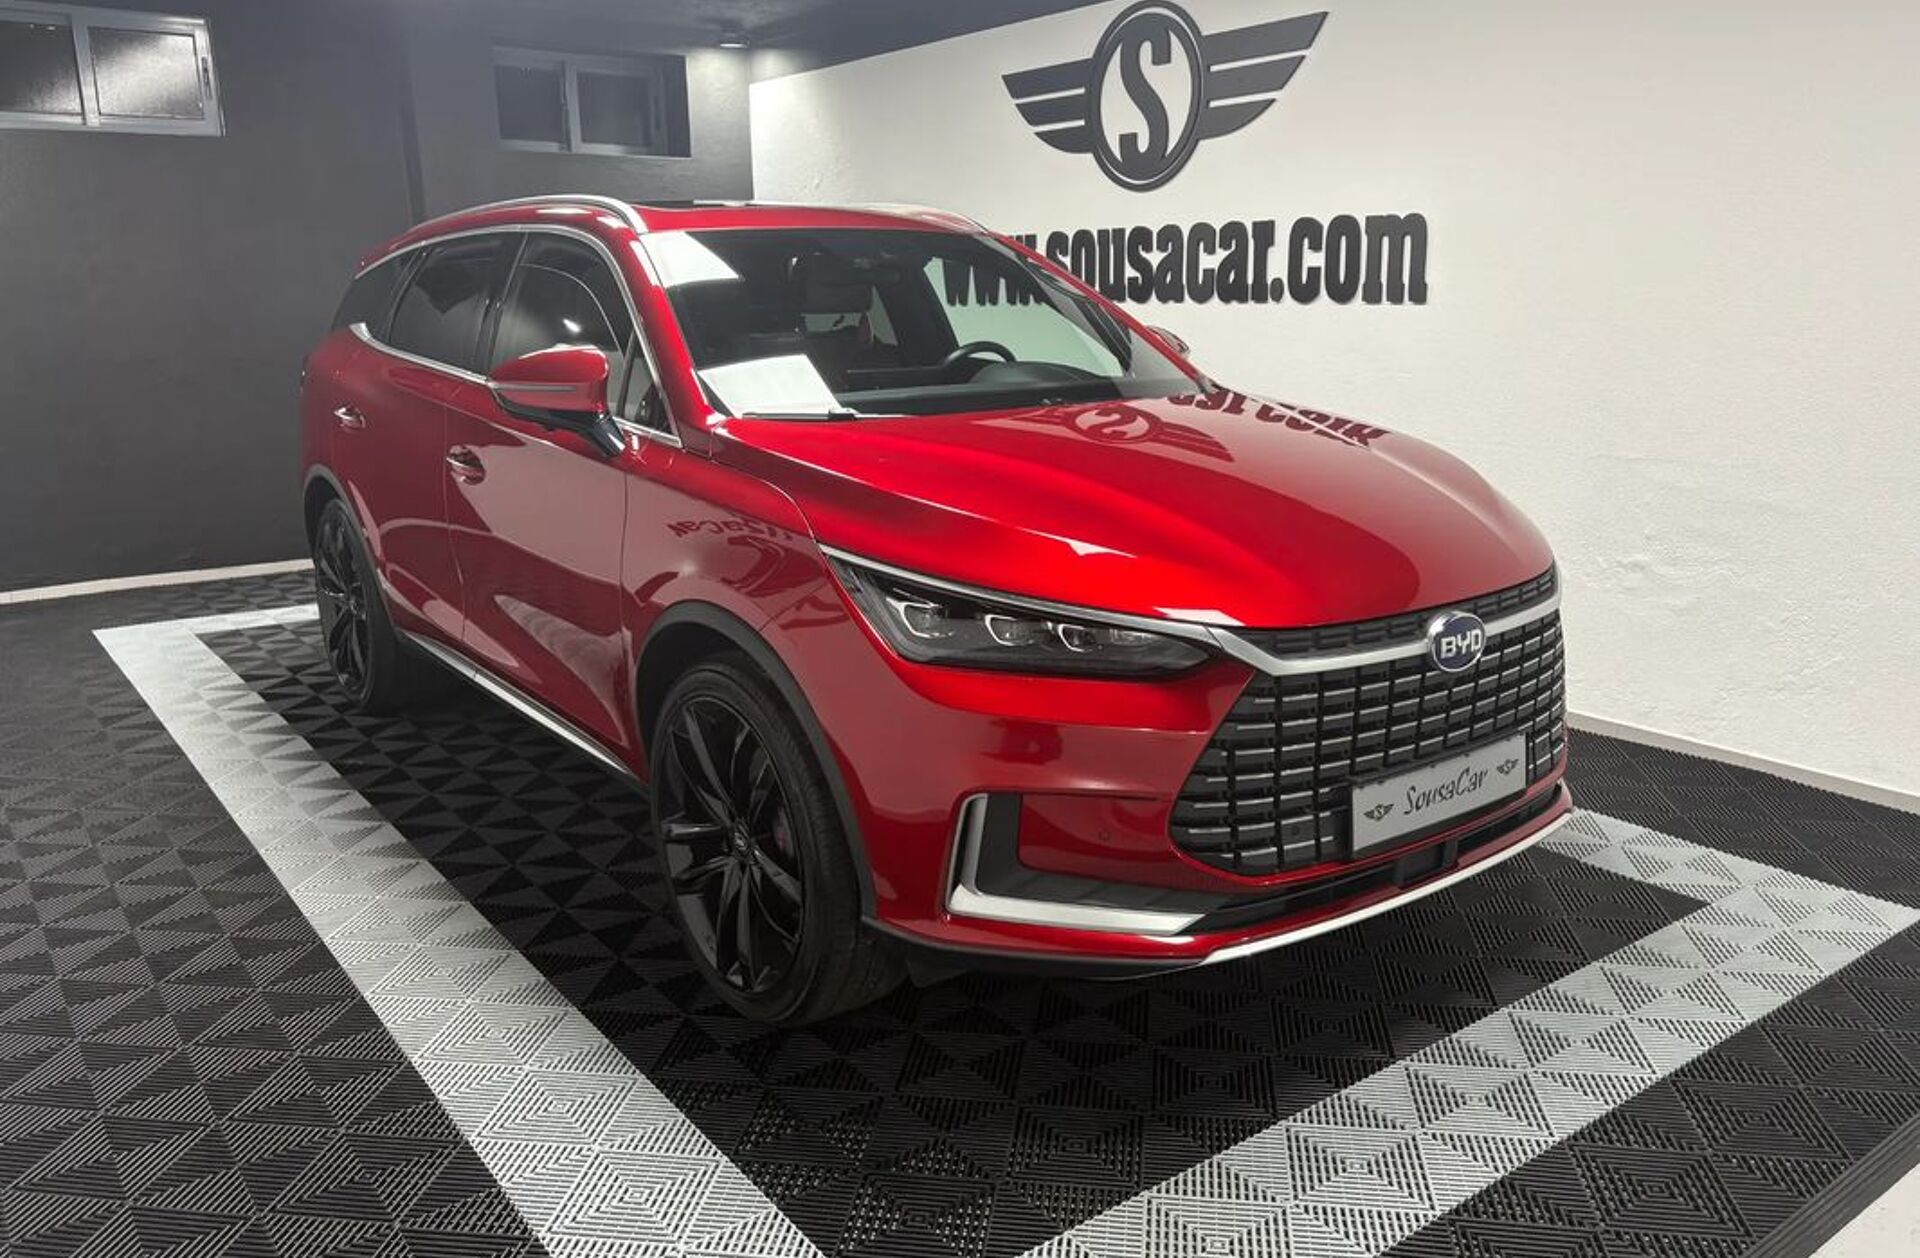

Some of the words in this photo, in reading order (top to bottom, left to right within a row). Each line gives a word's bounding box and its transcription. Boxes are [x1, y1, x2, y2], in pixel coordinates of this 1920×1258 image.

[1118, 22, 1172, 167] S
[1440, 628, 1482, 660] BYD
[1404, 766, 1489, 816] SousaCar
